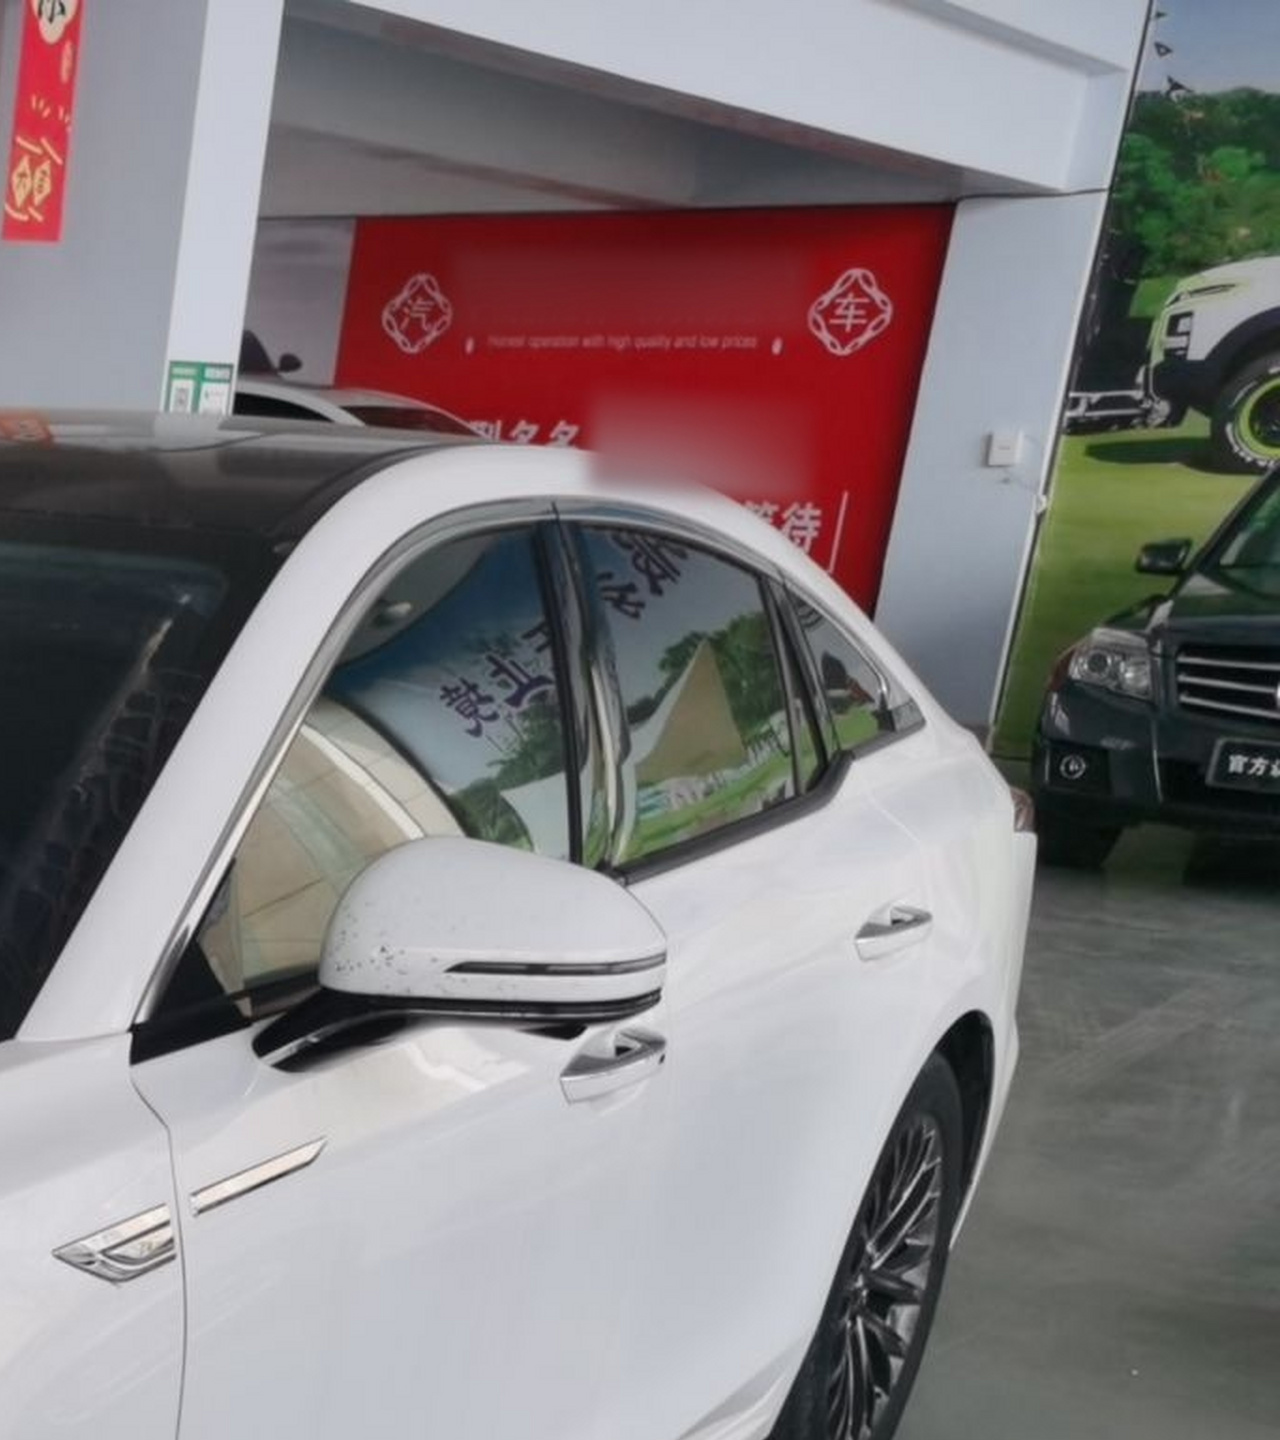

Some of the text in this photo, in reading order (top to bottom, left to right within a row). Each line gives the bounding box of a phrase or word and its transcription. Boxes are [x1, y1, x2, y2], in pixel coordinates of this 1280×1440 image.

[400, 296, 434, 330] 汽
[829, 292, 870, 332] 车
[528, 335, 579, 351] operation
[582, 334, 604, 349] with
[606, 334, 631, 352] high
[634, 334, 671, 352] quality
[673, 334, 696, 349] and
[700, 334, 719, 349] low
[721, 335, 757, 353] prices
